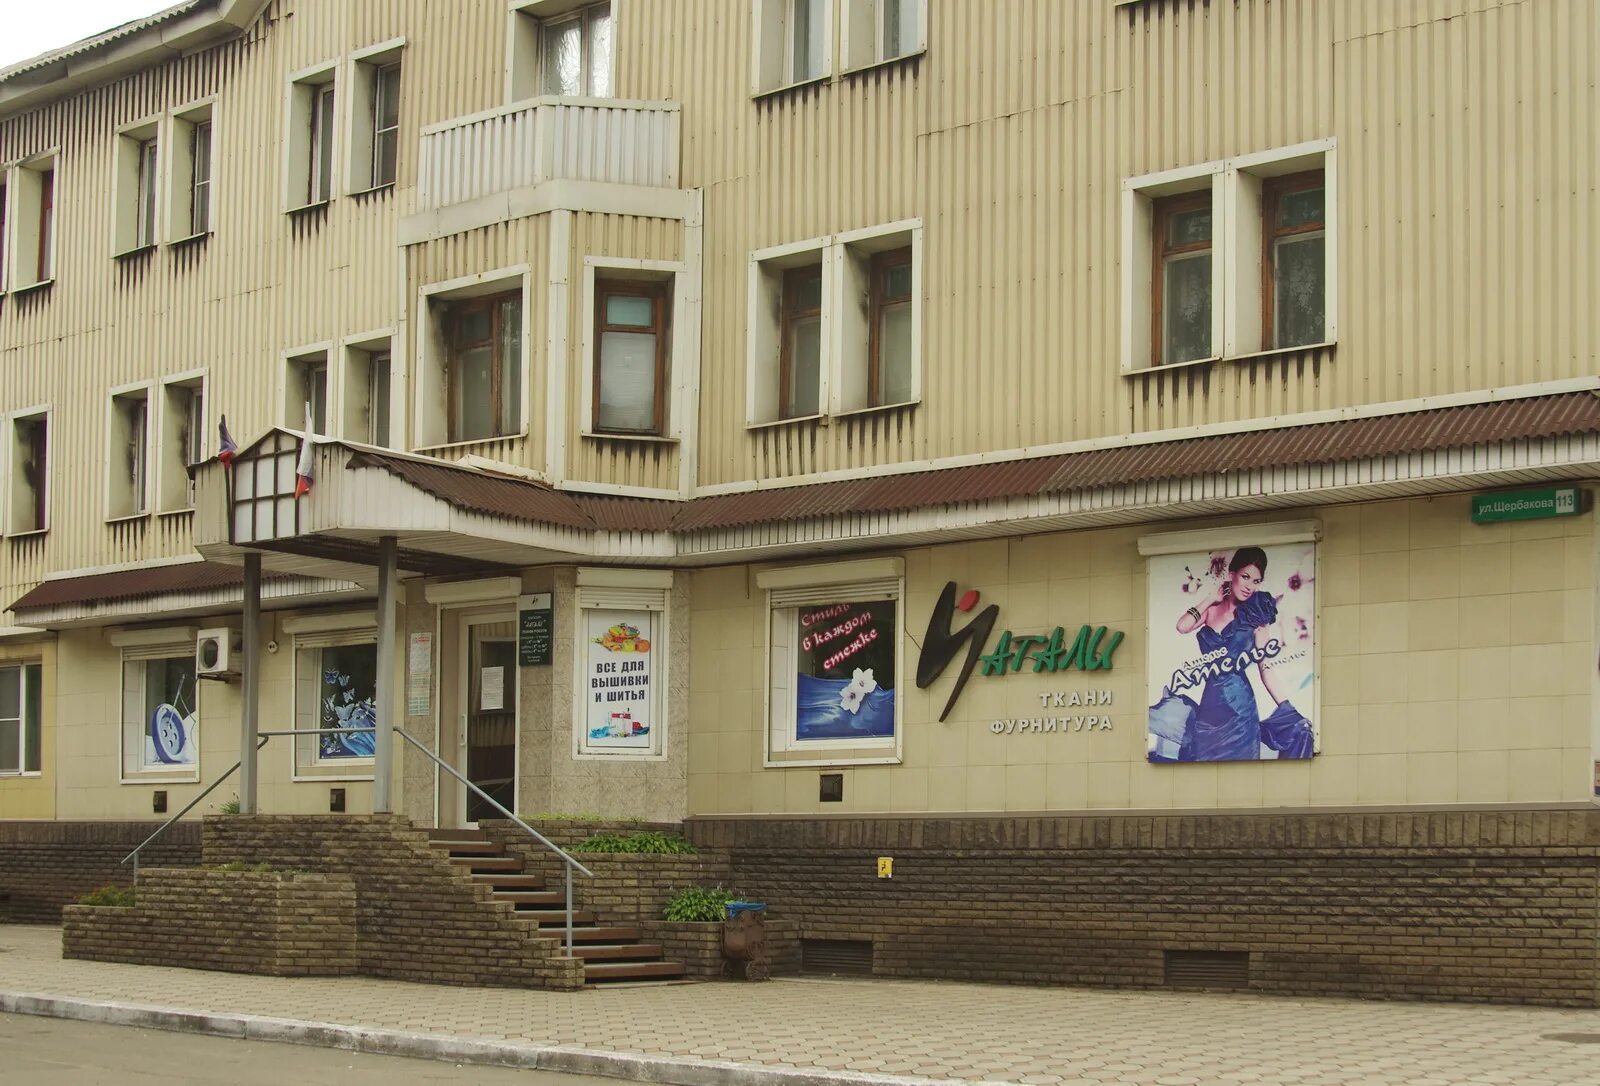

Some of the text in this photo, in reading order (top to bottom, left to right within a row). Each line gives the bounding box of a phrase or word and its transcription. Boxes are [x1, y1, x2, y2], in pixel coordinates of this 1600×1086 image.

[1478, 494, 1573, 515] ул.Щербакова 113
[813, 611, 872, 648] каждом
[823, 628, 878, 669] стежке
[596, 661, 645, 674] ВСЕ ДЛЯ
[1169, 638, 1282, 695] Ателье
[591, 675, 649, 688] ВЫШИВКИ
[595, 690, 645, 703] И ШИТЬЯ
[1040, 690, 1112, 707] ТКАНИ
[990, 716, 1112, 734] ФУРНИТУРА
